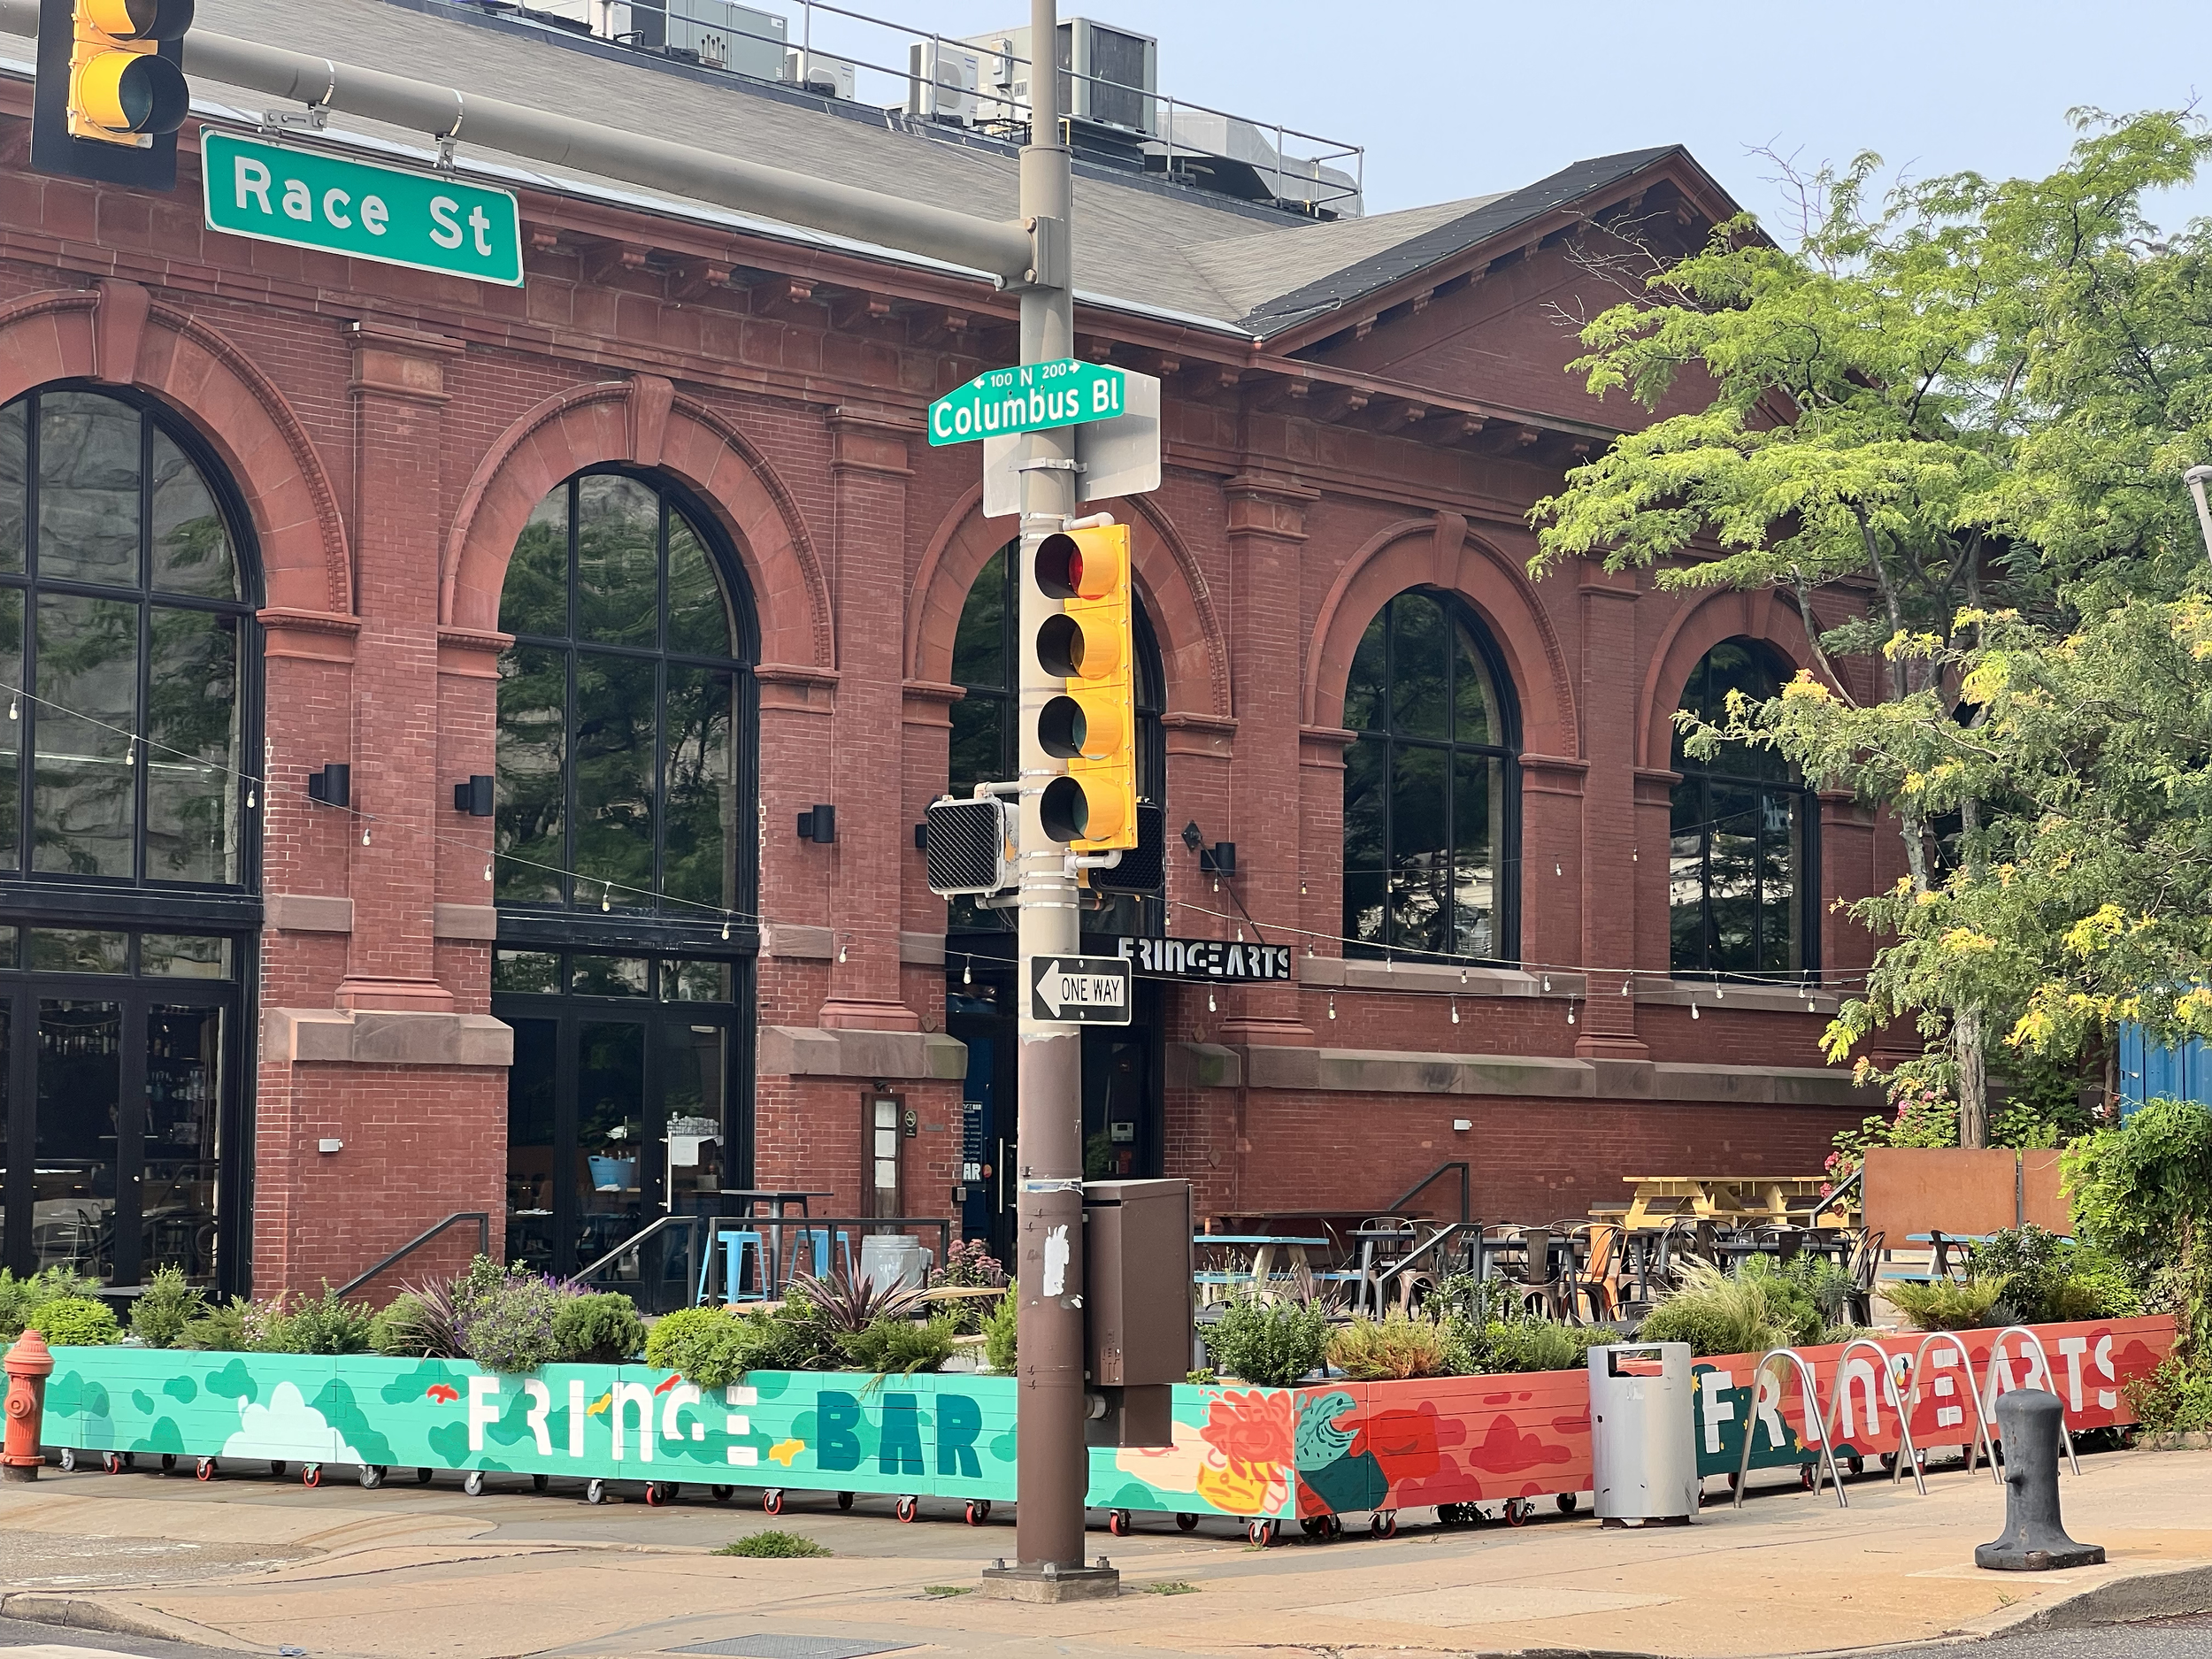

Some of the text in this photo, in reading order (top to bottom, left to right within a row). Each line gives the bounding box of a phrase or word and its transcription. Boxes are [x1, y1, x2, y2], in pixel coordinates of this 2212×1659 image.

[234, 156, 492, 257] Race St
[991, 363, 1067, 388] 100 N 200
[934, 377, 1119, 437] Columbus Bl
[1062, 977, 1120, 1002] ONE WAY
[963, 1163, 981, 1180] AR
[469, 1375, 984, 1478] FRINGE BAR
